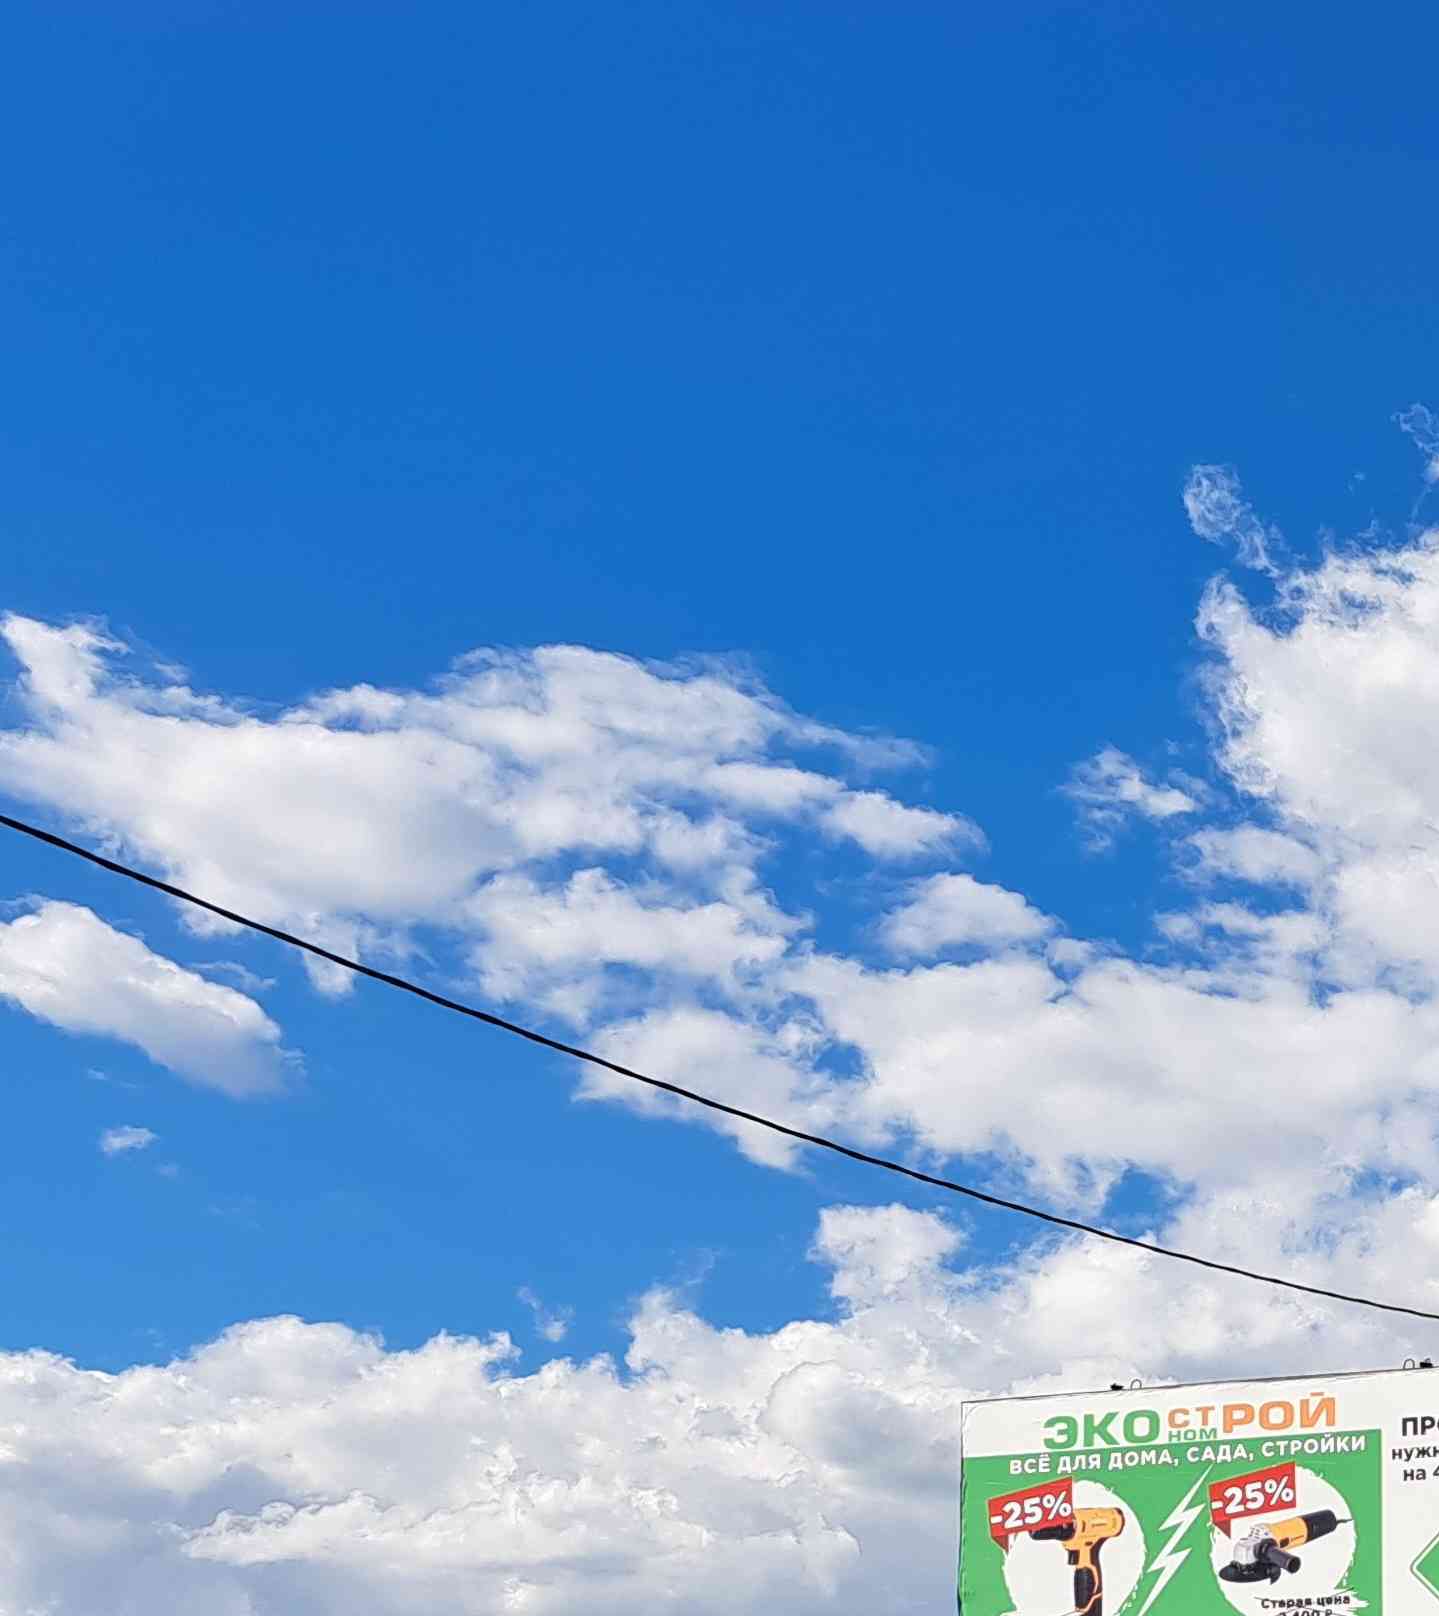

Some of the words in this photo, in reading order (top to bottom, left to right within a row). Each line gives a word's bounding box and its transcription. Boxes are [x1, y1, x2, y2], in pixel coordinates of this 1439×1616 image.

[1009, 1452, 1050, 1475] ВСЁ
[1057, 1453, 1101, 1474] ДЛЯ
[1108, 1449, 1179, 1470] ДОМА,
[1187, 1443, 1254, 1463] САДА,
[1261, 1432, 1366, 1457] СТРОЙКИ
[1403, 1467, 1427, 1482] на
[990, 1491, 1072, 1529] -25%
[1211, 1475, 1295, 1515] -25%
[1261, 1597, 1312, 1609] Старая
[1317, 1595, 1351, 1607] цена
